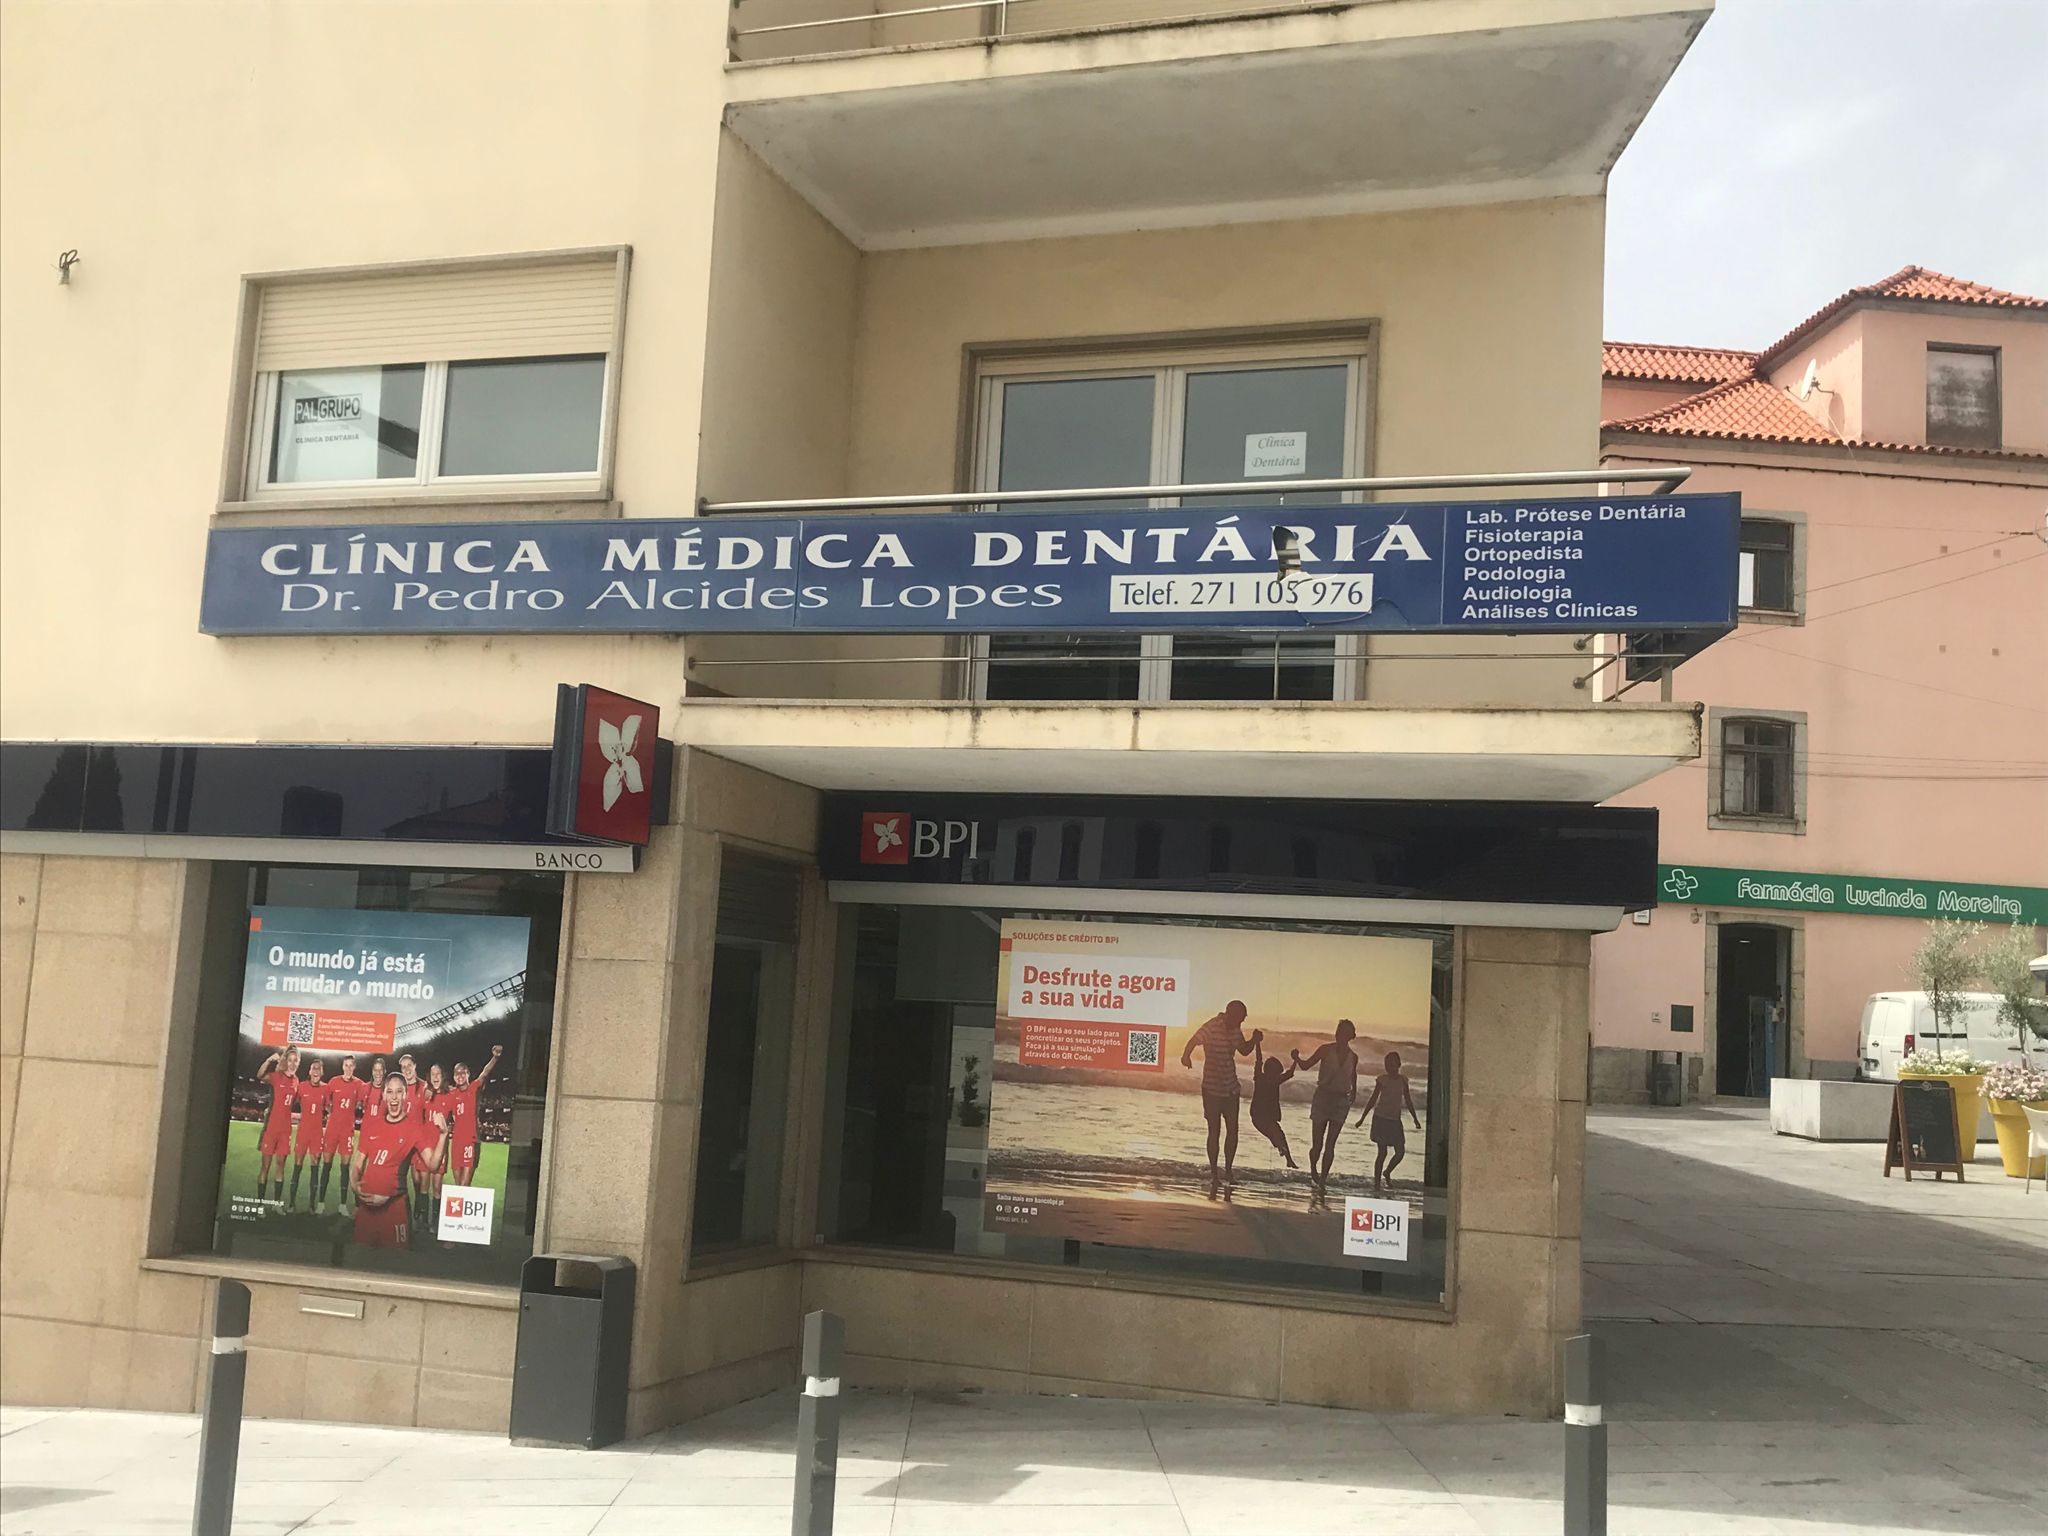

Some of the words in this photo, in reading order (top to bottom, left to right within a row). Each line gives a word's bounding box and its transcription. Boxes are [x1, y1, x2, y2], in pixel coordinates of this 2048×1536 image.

[295, 397, 361, 421] PALGRUPO
[1466, 509, 1508, 525] Lab.
[1515, 507, 1592, 523] Prótese
[1599, 504, 1686, 521] Dentária
[1465, 527, 1584, 544] Fisioterapia
[260, 533, 550, 576] CLÍNICA
[602, 528, 914, 574] MÉDICA
[971, 515, 1432, 567] DENTÁRIA
[1464, 545, 1584, 563] Ortopedista
[1463, 567, 1566, 584] Podologia
[280, 584, 361, 612] Dr.
[393, 581, 565, 612] Pedro
[586, 577, 829, 611] Alcides
[861, 577, 1064, 620] Lopes
[1119, 582, 1180, 606] Telef.
[1190, 581, 1236, 606] 271
[1312, 580, 1364, 606] 976
[1462, 586, 1573, 603] Audiologia
[1461, 604, 1549, 620] Análises
[1555, 602, 1639, 619] Clínicas
[913, 819, 980, 860] BPI
[535, 851, 603, 869] BANCO
[1738, 878, 1834, 903] Farmácia
[1846, 884, 1927, 909] Lucinda
[1937, 890, 2022, 915] Moreira
[1012, 932, 1055, 943] SOLUÇÕES
[1056, 934, 1067, 942] DE
[1069, 933, 1103, 943] CRÉDITO
[1105, 936, 1120, 944] BPI
[269, 945, 285, 966] O
[289, 949, 355, 970] mundo
[358, 949, 378, 975] já
[382, 952, 426, 974] está
[265, 975, 277, 991] a
[282, 974, 345, 995] mudar
[349, 981, 361, 995] o
[366, 979, 434, 1000] mundo
[1023, 965, 1112, 988] Desfrute
[1118, 974, 1176, 994] agora
[1021, 990, 1034, 1005] a
[1039, 990, 1075, 1007] sua
[1080, 989, 1125, 1010] vida
[1047, 1026, 1062, 1034] está
[1087, 1028, 1102, 1036] lado
[1103, 1030, 1120, 1038] para
[1025, 1042, 1041, 1050] Faça
[1061, 1052, 1073, 1060] QR
[340, 1098, 350, 1108] 24
[373, 1149, 389, 1166] 19
[464, 1146, 473, 1158] 20
[464, 1200, 487, 1217] BPI
[1373, 1213, 1401, 1231] BPI
[395, 1224, 407, 1243] 19
